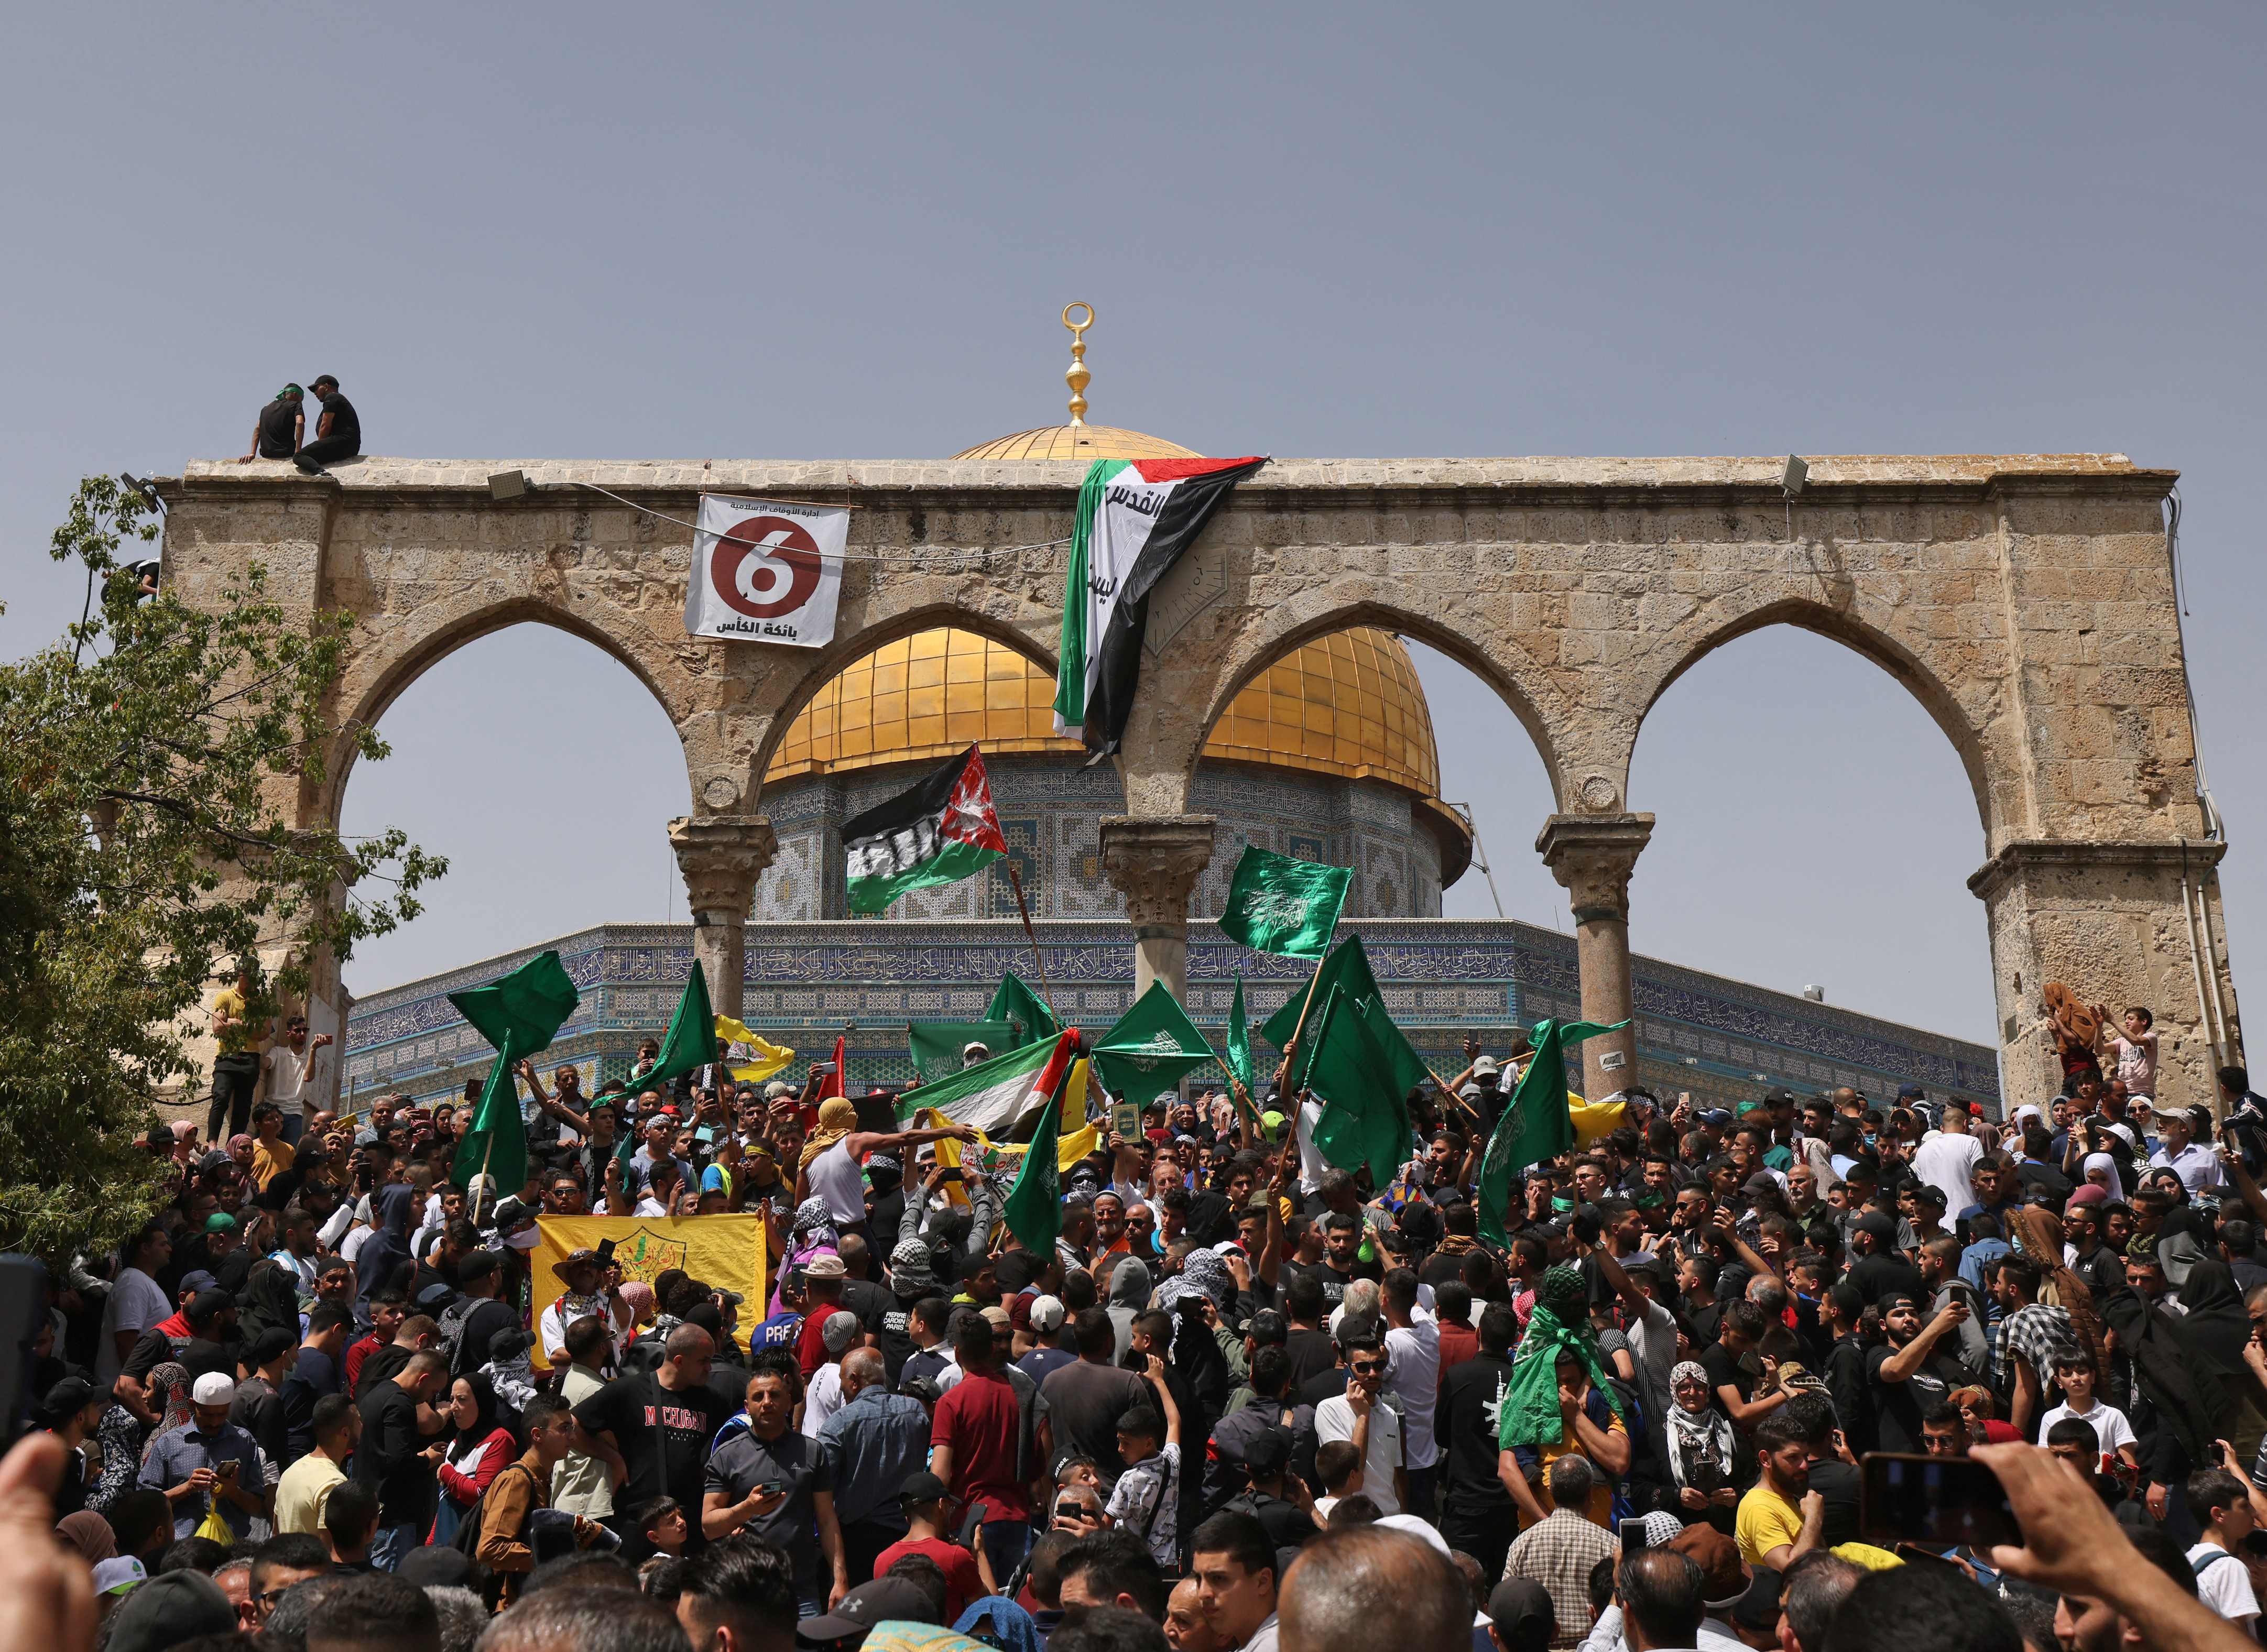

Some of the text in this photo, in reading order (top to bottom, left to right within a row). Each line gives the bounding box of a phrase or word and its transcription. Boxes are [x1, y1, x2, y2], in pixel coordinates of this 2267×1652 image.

[730, 501, 767, 513] الإسلامية
[1106, 486, 1165, 518] القدس
[800, 510, 820, 519] إدارة
[716, 617, 798, 641] بائكة الكأس
[644, 1405, 706, 1434] MCHIGAN
